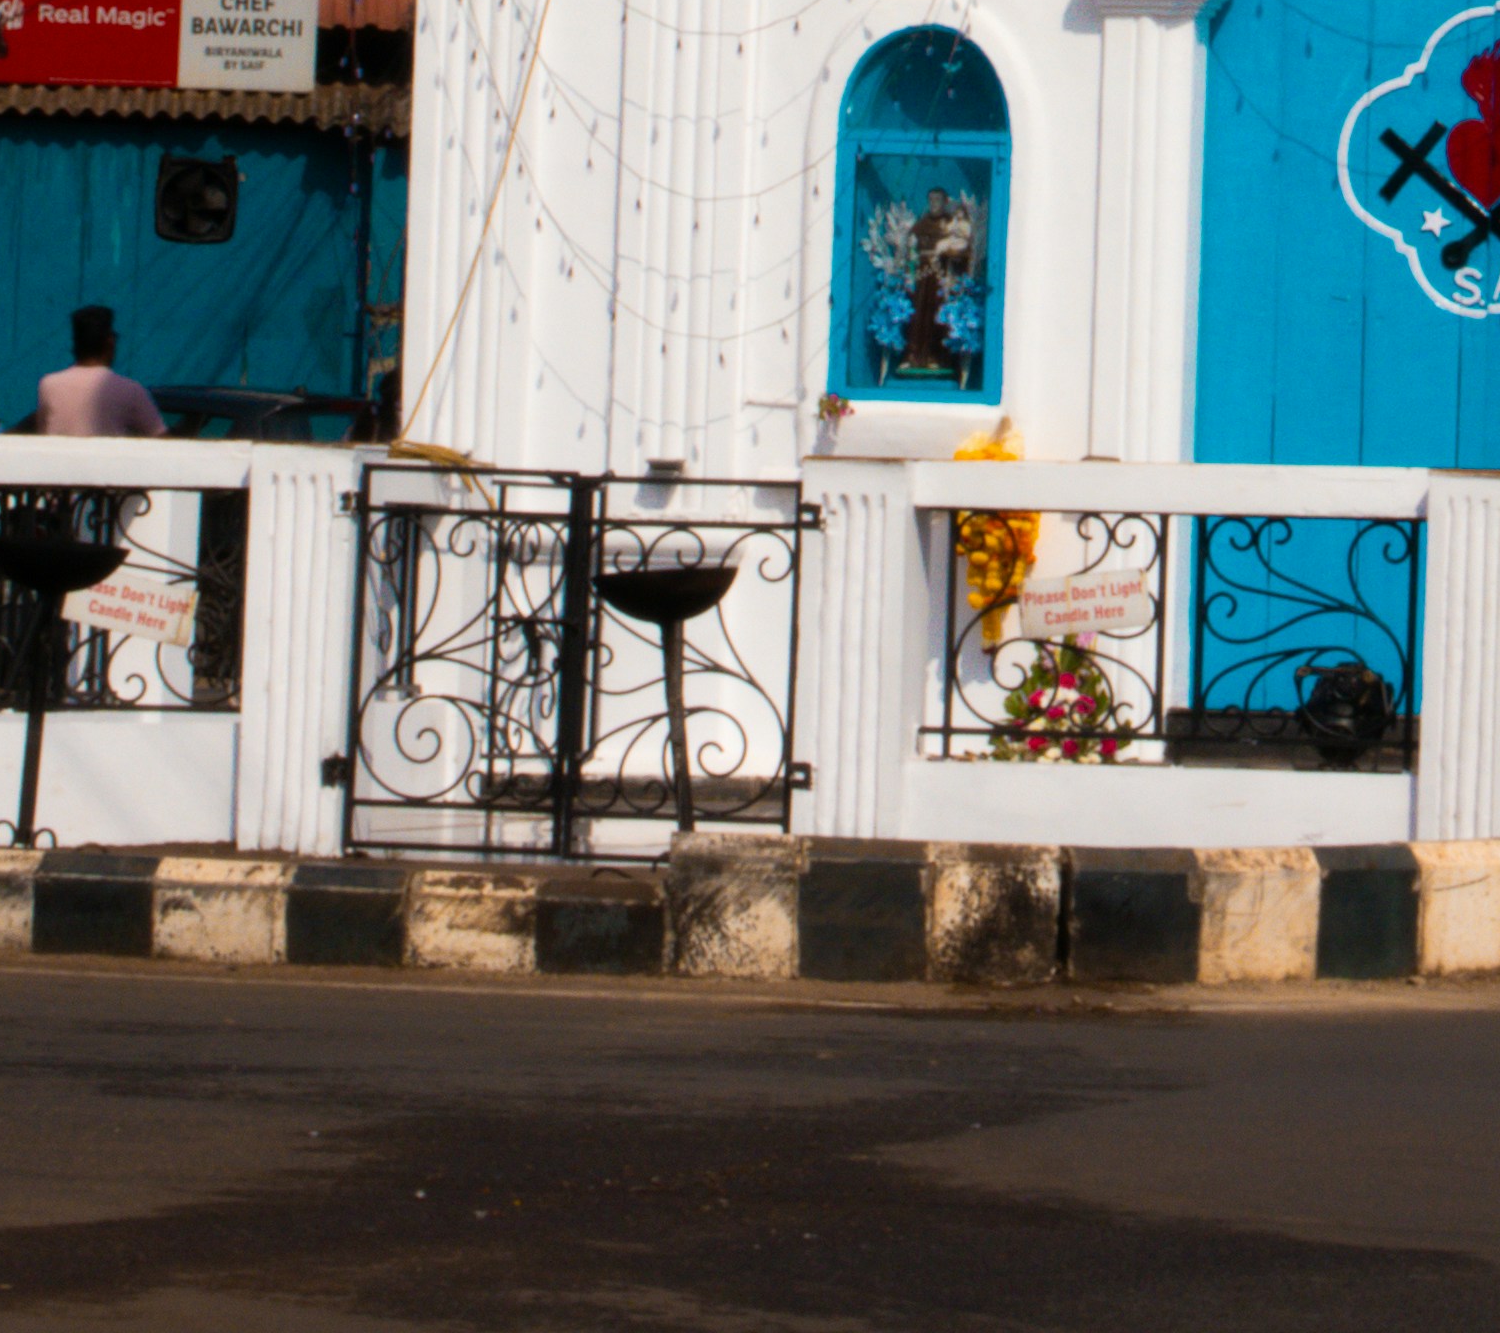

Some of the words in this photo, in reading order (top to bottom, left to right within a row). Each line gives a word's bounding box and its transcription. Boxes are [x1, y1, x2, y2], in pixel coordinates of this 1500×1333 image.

[37, 3, 90, 25] Real
[96, 6, 167, 30] Magic
[191, 17, 304, 37] BAWARCHI
[223, 60, 238, 70] BY
[120, 585, 155, 605] Don't
[158, 595, 190, 615] Light
[1023, 590, 1067, 606] Please
[1071, 583, 1107, 601] Don't
[1110, 581, 1143, 598] Light
[88, 599, 133, 622] Candle
[137, 611, 167, 631] Here
[1044, 607, 1090, 625] Candle
[1094, 605, 1126, 620] Here
